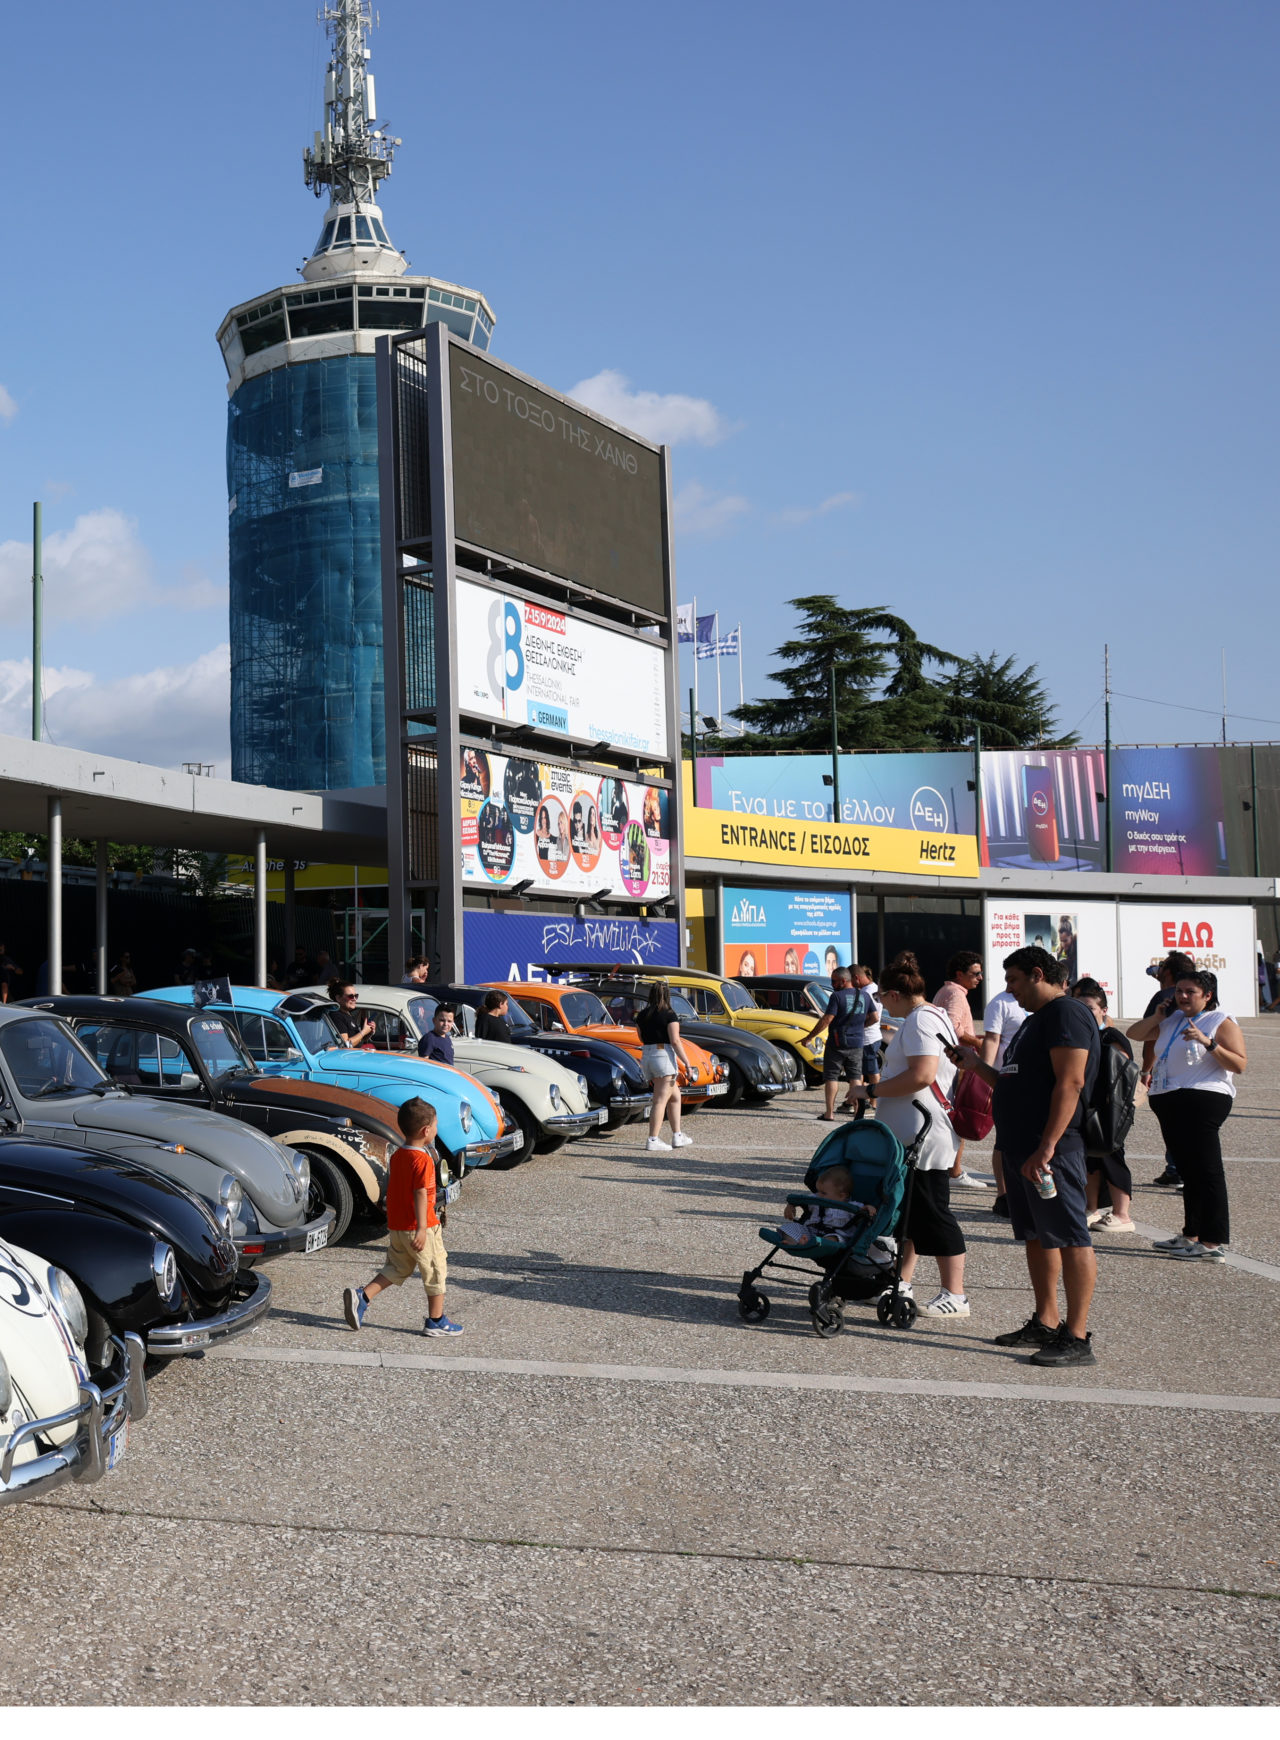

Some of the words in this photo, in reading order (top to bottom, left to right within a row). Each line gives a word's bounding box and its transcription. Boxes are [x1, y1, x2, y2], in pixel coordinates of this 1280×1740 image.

[459, 366, 499, 404] ΣΤΟ
[503, 388, 555, 433] ΤΟΞΟ
[558, 417, 591, 451] ΤΗΣ
[595, 435, 638, 475] ΧΑΝΘ
[525, 635, 556, 655] ΔΙΕΘΝΗΣ
[557, 643, 583, 663] ΕΚΘΕΣΗ
[525, 649, 576, 676] ΘΕΣΣΑΛΟΝΙΚΗΣ
[537, 711, 567, 729] GERMANY
[551, 769, 571, 784] music
[550, 781, 572, 794] events
[729, 790, 767, 816] Ένα
[774, 800, 797, 818] με
[801, 800, 825, 819] το
[839, 798, 895, 824] έλλον
[914, 801, 944, 828] ΔΕΗ
[1125, 808, 1160, 825] myWay
[721, 824, 796, 852] ENTRANCE
[811, 833, 870, 856] ΕΙΣΟΔΟΣ
[920, 840, 956, 861] Hertz
[651, 871, 669, 886] 21:30
[731, 898, 767, 922] ΔΥΠΑ
[993, 912, 1003, 921] Για
[1004, 912, 1020, 921] κάθε
[991, 922, 1003, 931] μας
[1004, 921, 1020, 931] βήμα
[1161, 921, 1214, 948] ΕΔΩ
[992, 938, 1020, 949] μπροστά
[996, 932, 1012, 941] προς
[1186, 951, 1227, 971] ράξη
